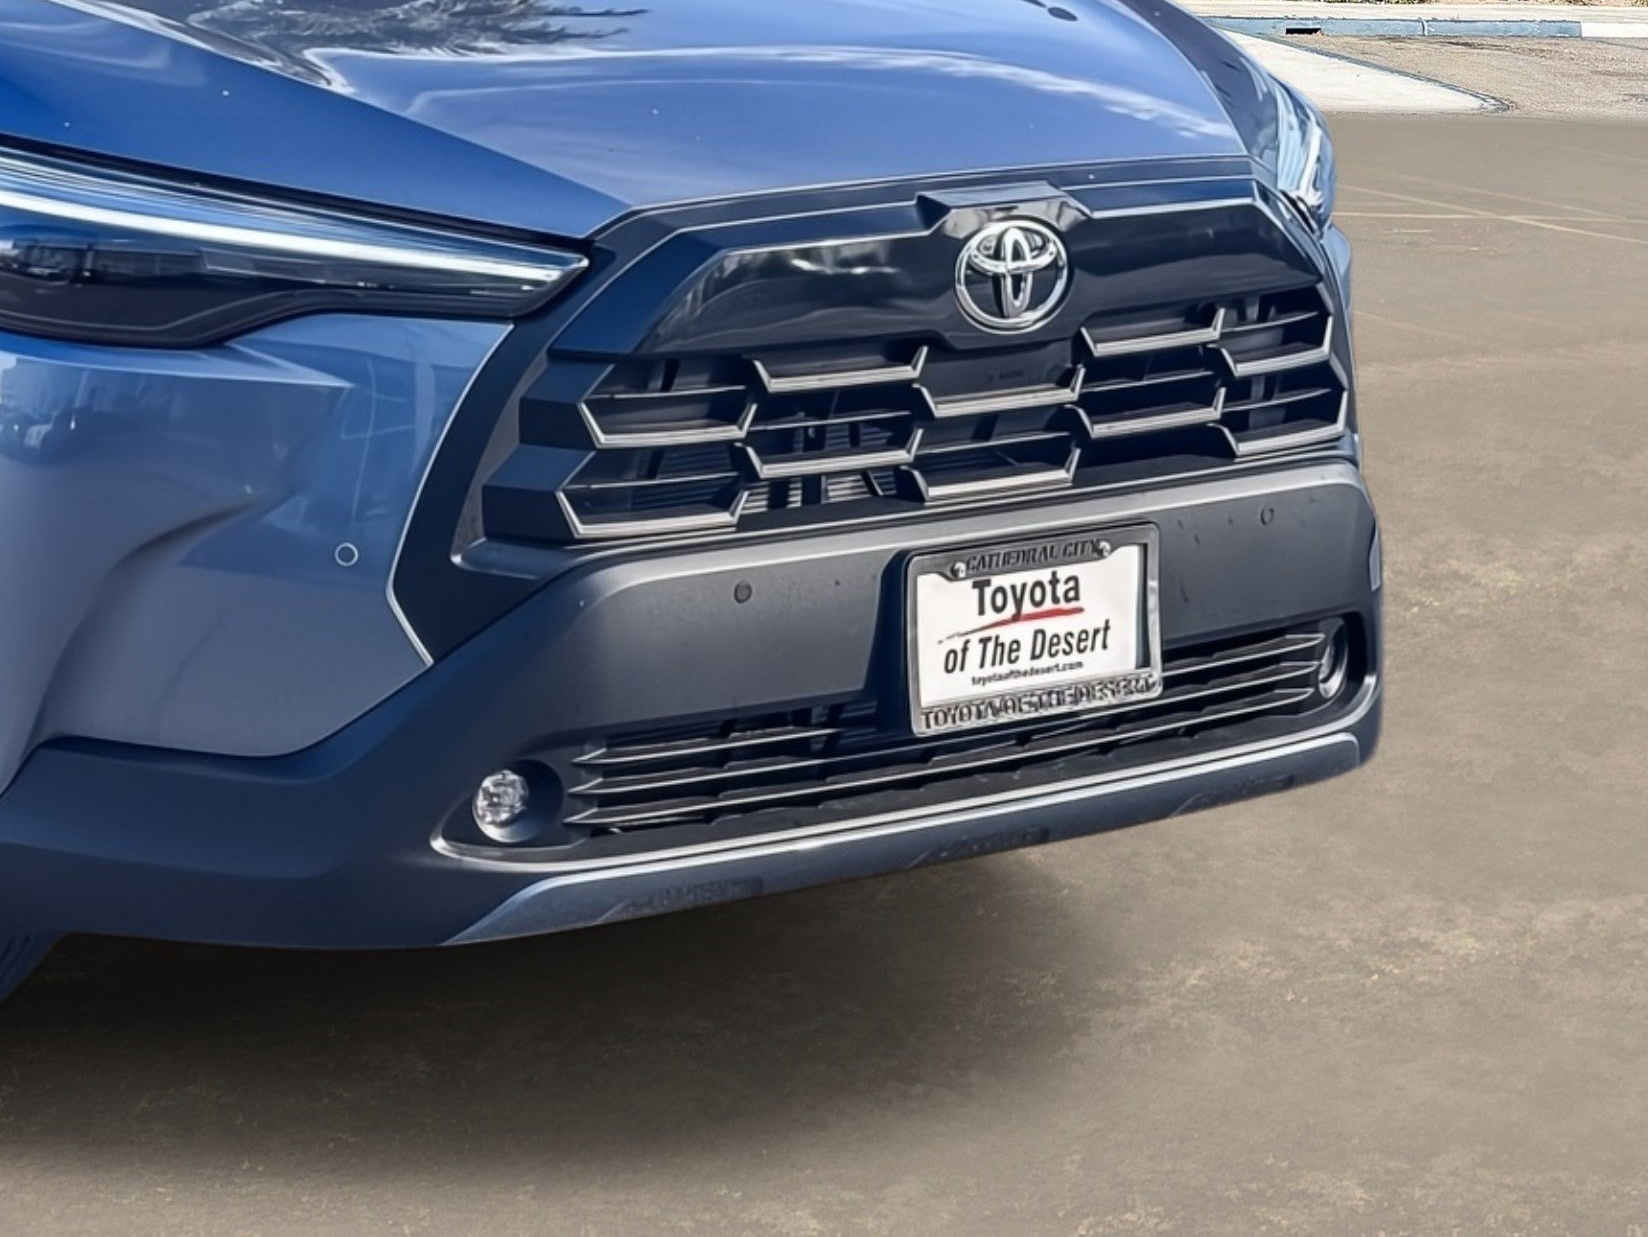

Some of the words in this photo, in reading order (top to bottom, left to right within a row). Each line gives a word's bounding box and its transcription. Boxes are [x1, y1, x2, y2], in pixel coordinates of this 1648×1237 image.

[965, 544, 1058, 572] CATHEDRAL
[1062, 538, 1103, 558] CITY
[972, 570, 1081, 622] Toyota
[944, 638, 972, 674] of
[978, 634, 1021, 669] The
[1030, 619, 1112, 661] Desert
[921, 693, 1001, 730] TOYOTA
